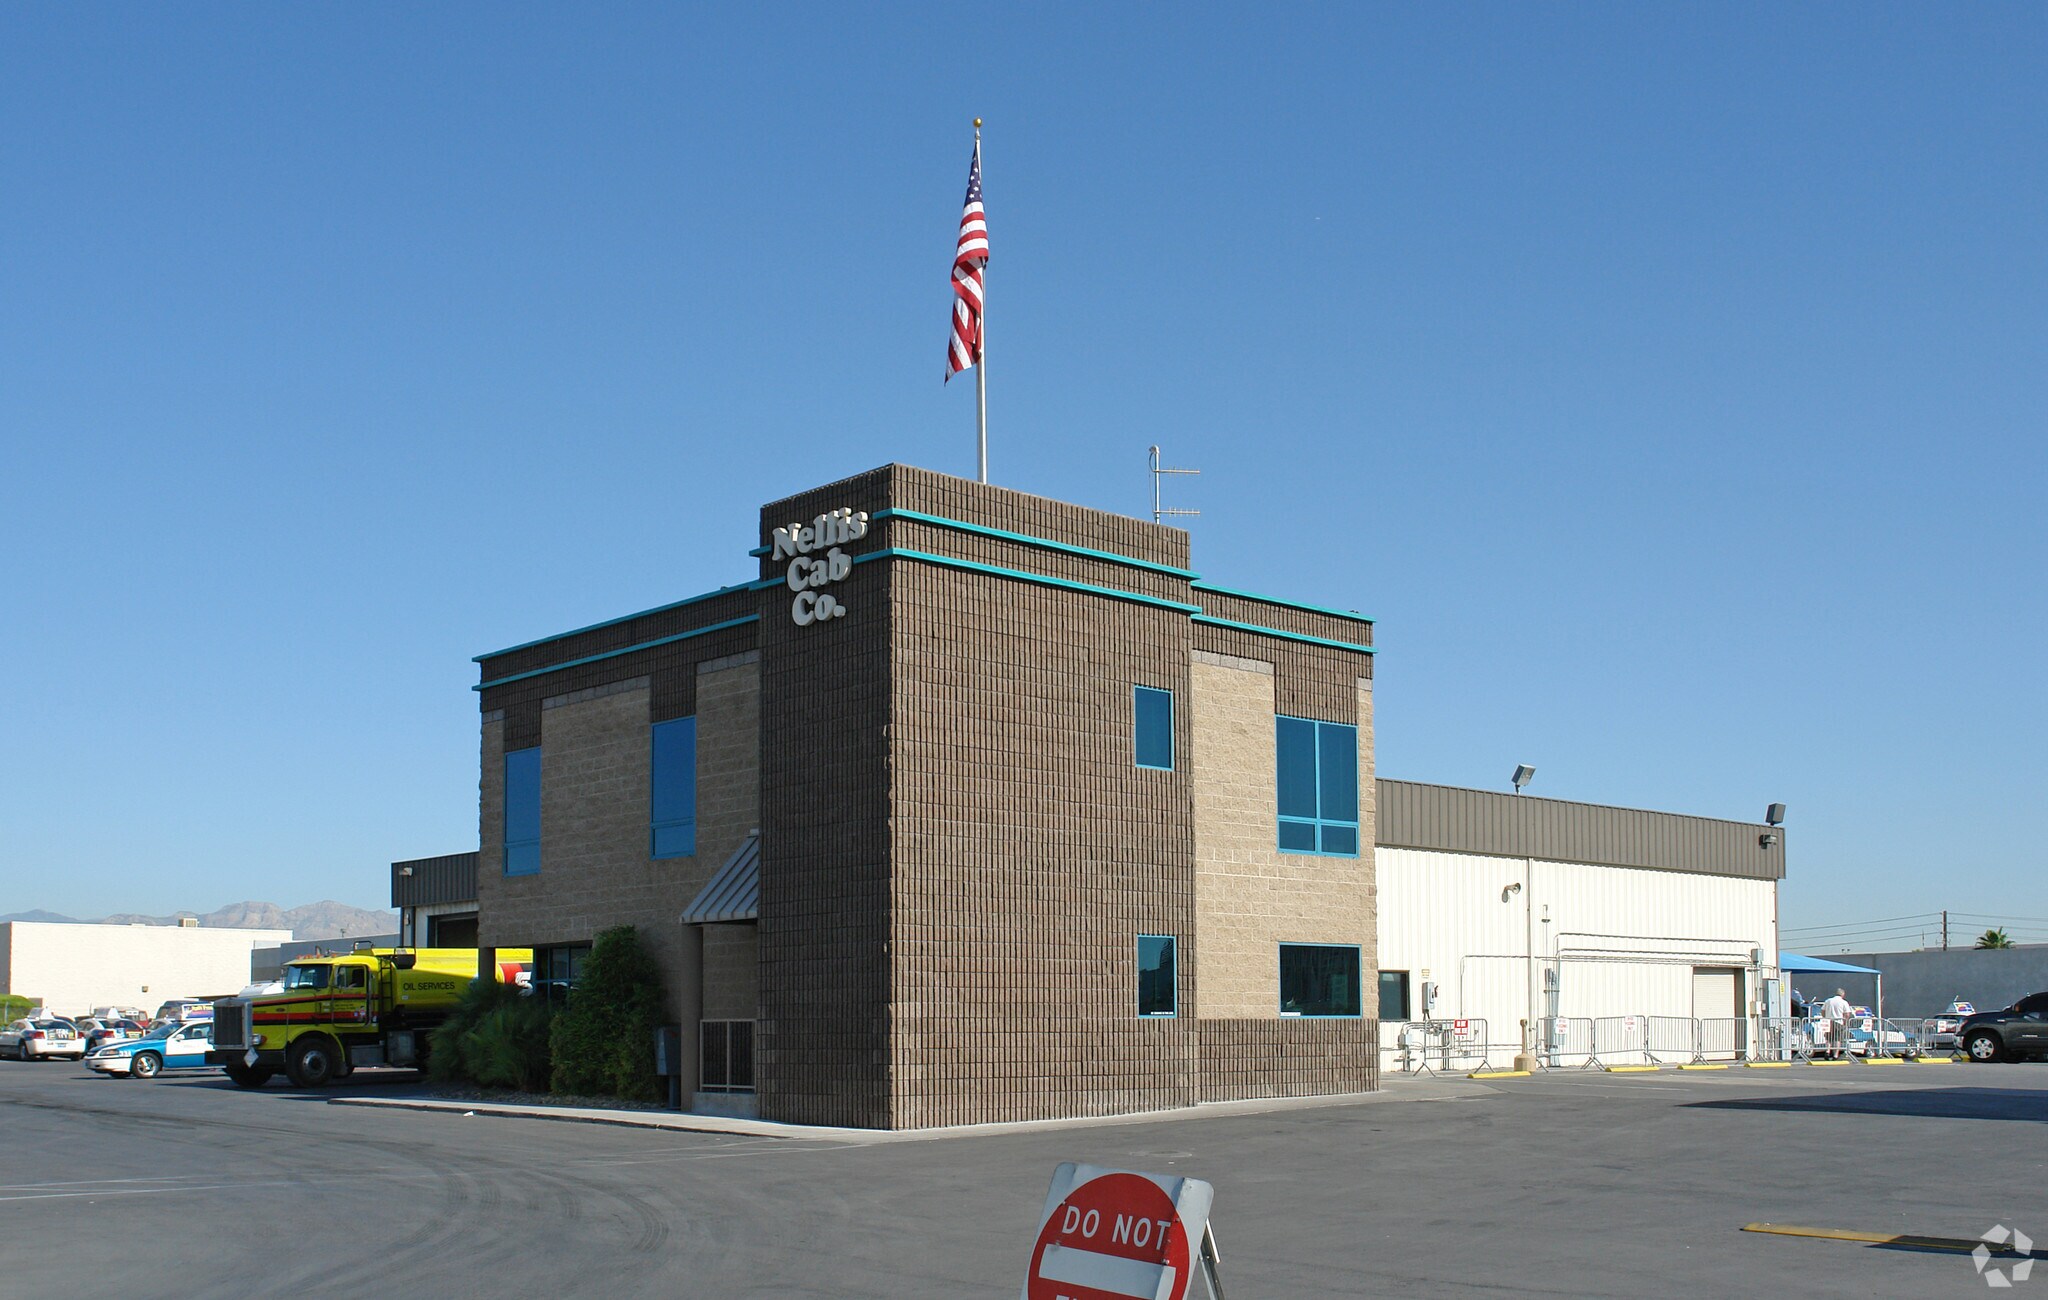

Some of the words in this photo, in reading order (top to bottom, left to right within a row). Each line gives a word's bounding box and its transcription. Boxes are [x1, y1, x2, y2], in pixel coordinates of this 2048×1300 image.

[772, 507, 868, 561] Nellis
[787, 547, 852, 592] Cab
[792, 591, 846, 626] Co.
[403, 982, 417, 991] OIL
[418, 981, 455, 991] SERVICES
[1062, 1205, 1100, 1238] DO
[1112, 1213, 1171, 1250] NOT
